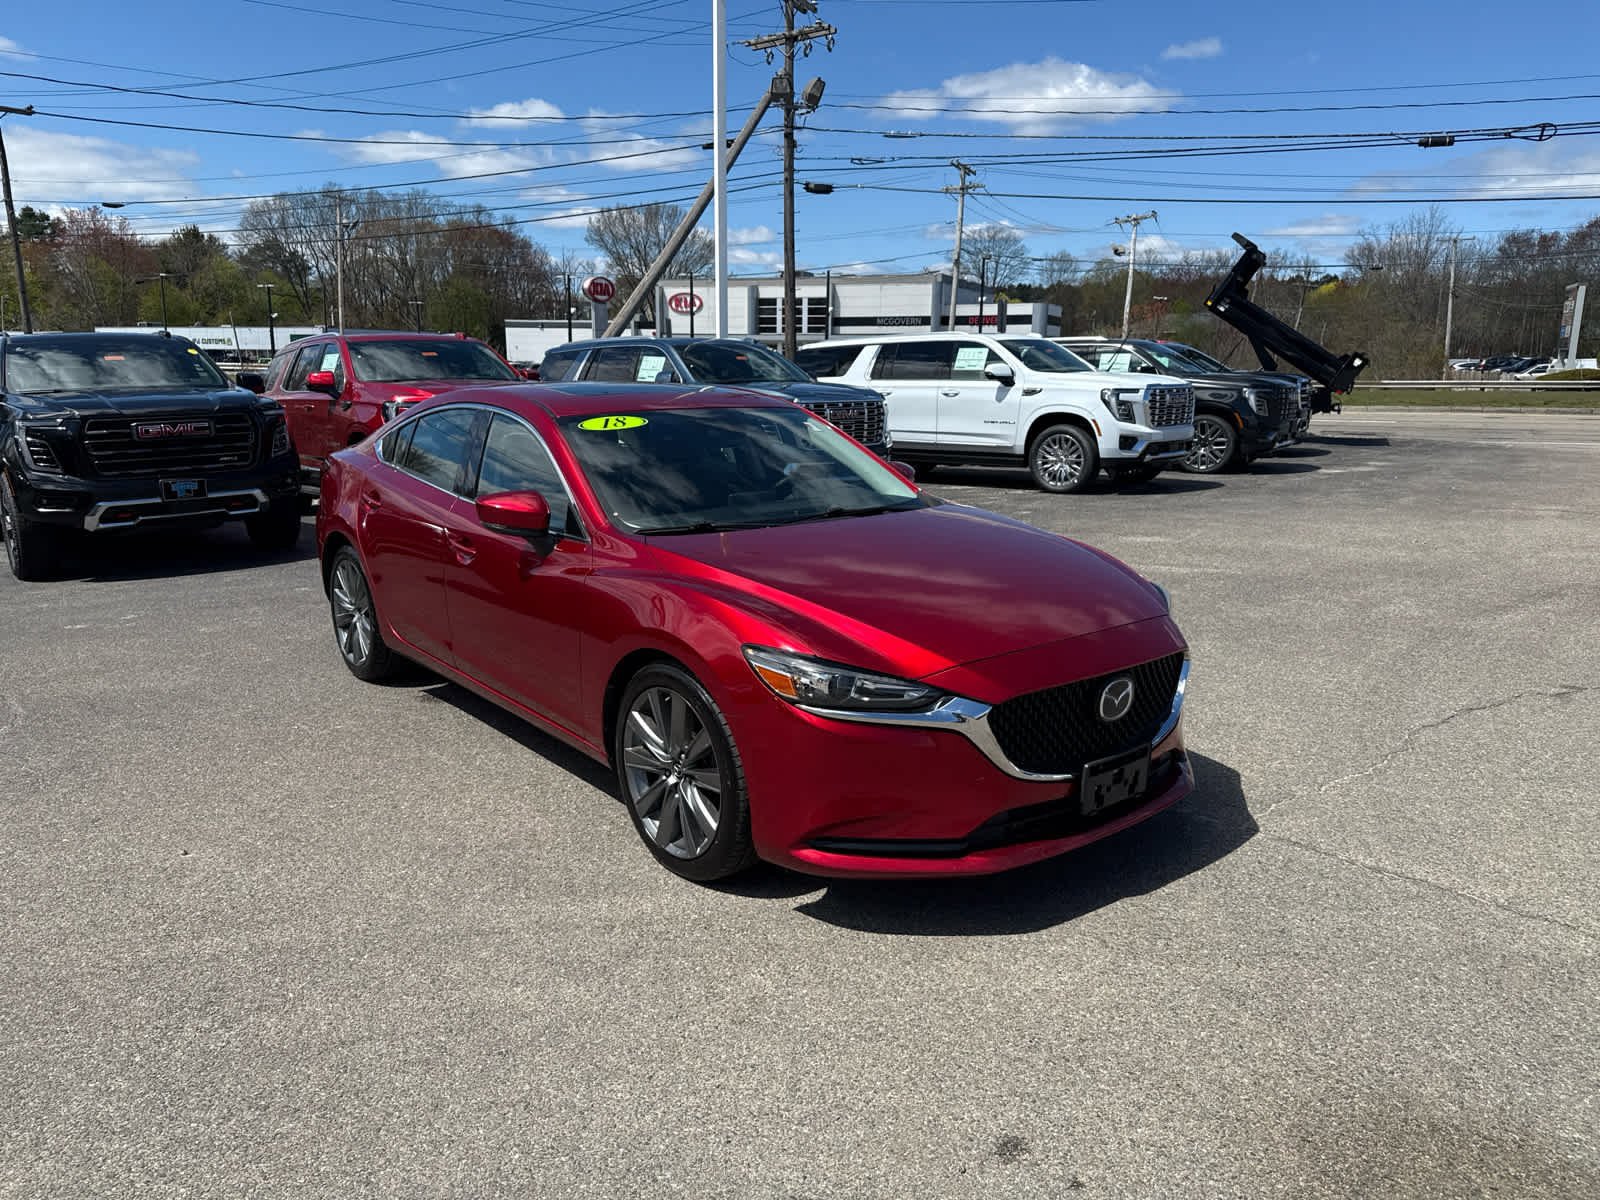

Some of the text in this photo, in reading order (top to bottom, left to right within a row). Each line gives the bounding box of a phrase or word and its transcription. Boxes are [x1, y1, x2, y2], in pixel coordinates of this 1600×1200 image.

[876, 317, 921, 325] MCGOVERN
[603, 416, 626, 429] 18
[137, 422, 209, 439] GMC
